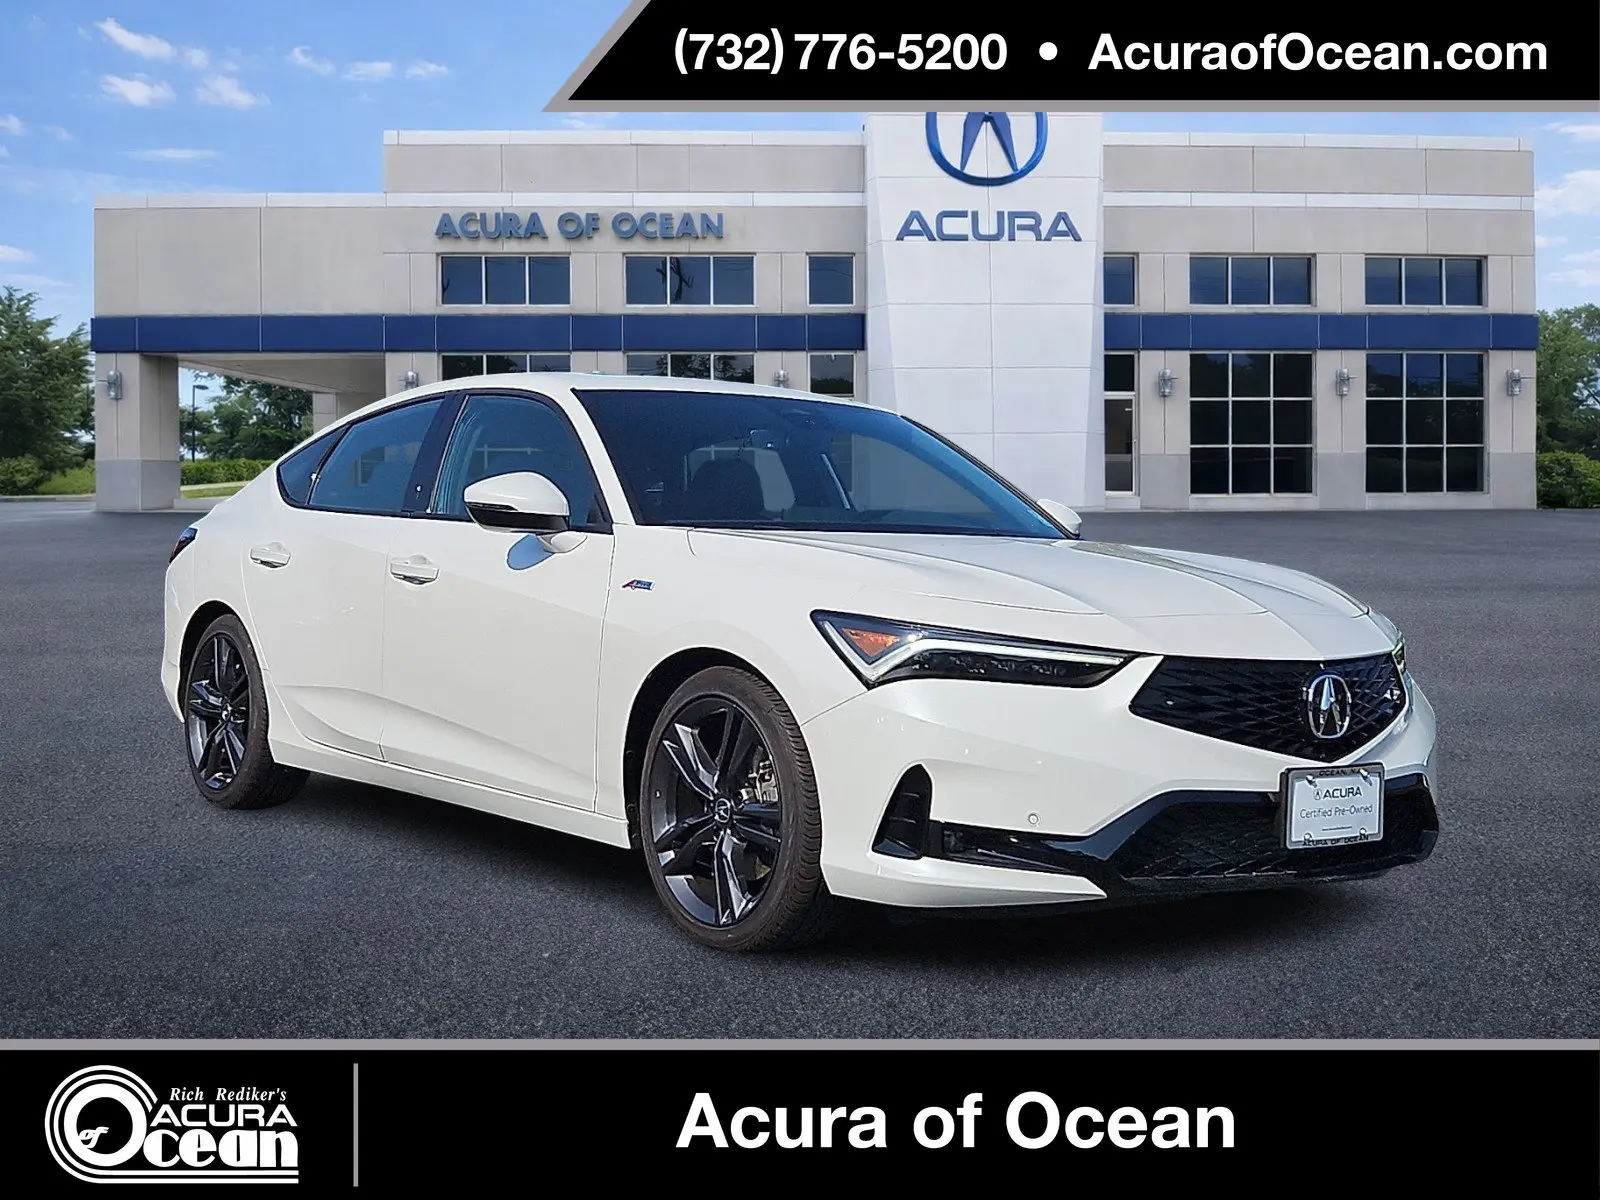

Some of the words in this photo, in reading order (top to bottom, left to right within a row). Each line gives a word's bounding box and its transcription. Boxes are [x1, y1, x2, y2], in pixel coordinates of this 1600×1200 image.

[435, 212, 547, 239] ACURA
[557, 212, 600, 239] OF
[611, 212, 723, 239] OCEAN
[896, 210, 1082, 241] ACURA
[1323, 787, 1362, 799] ACURA
[1300, 808, 1332, 818] Certified
[1334, 804, 1373, 816] Pre-Owned
